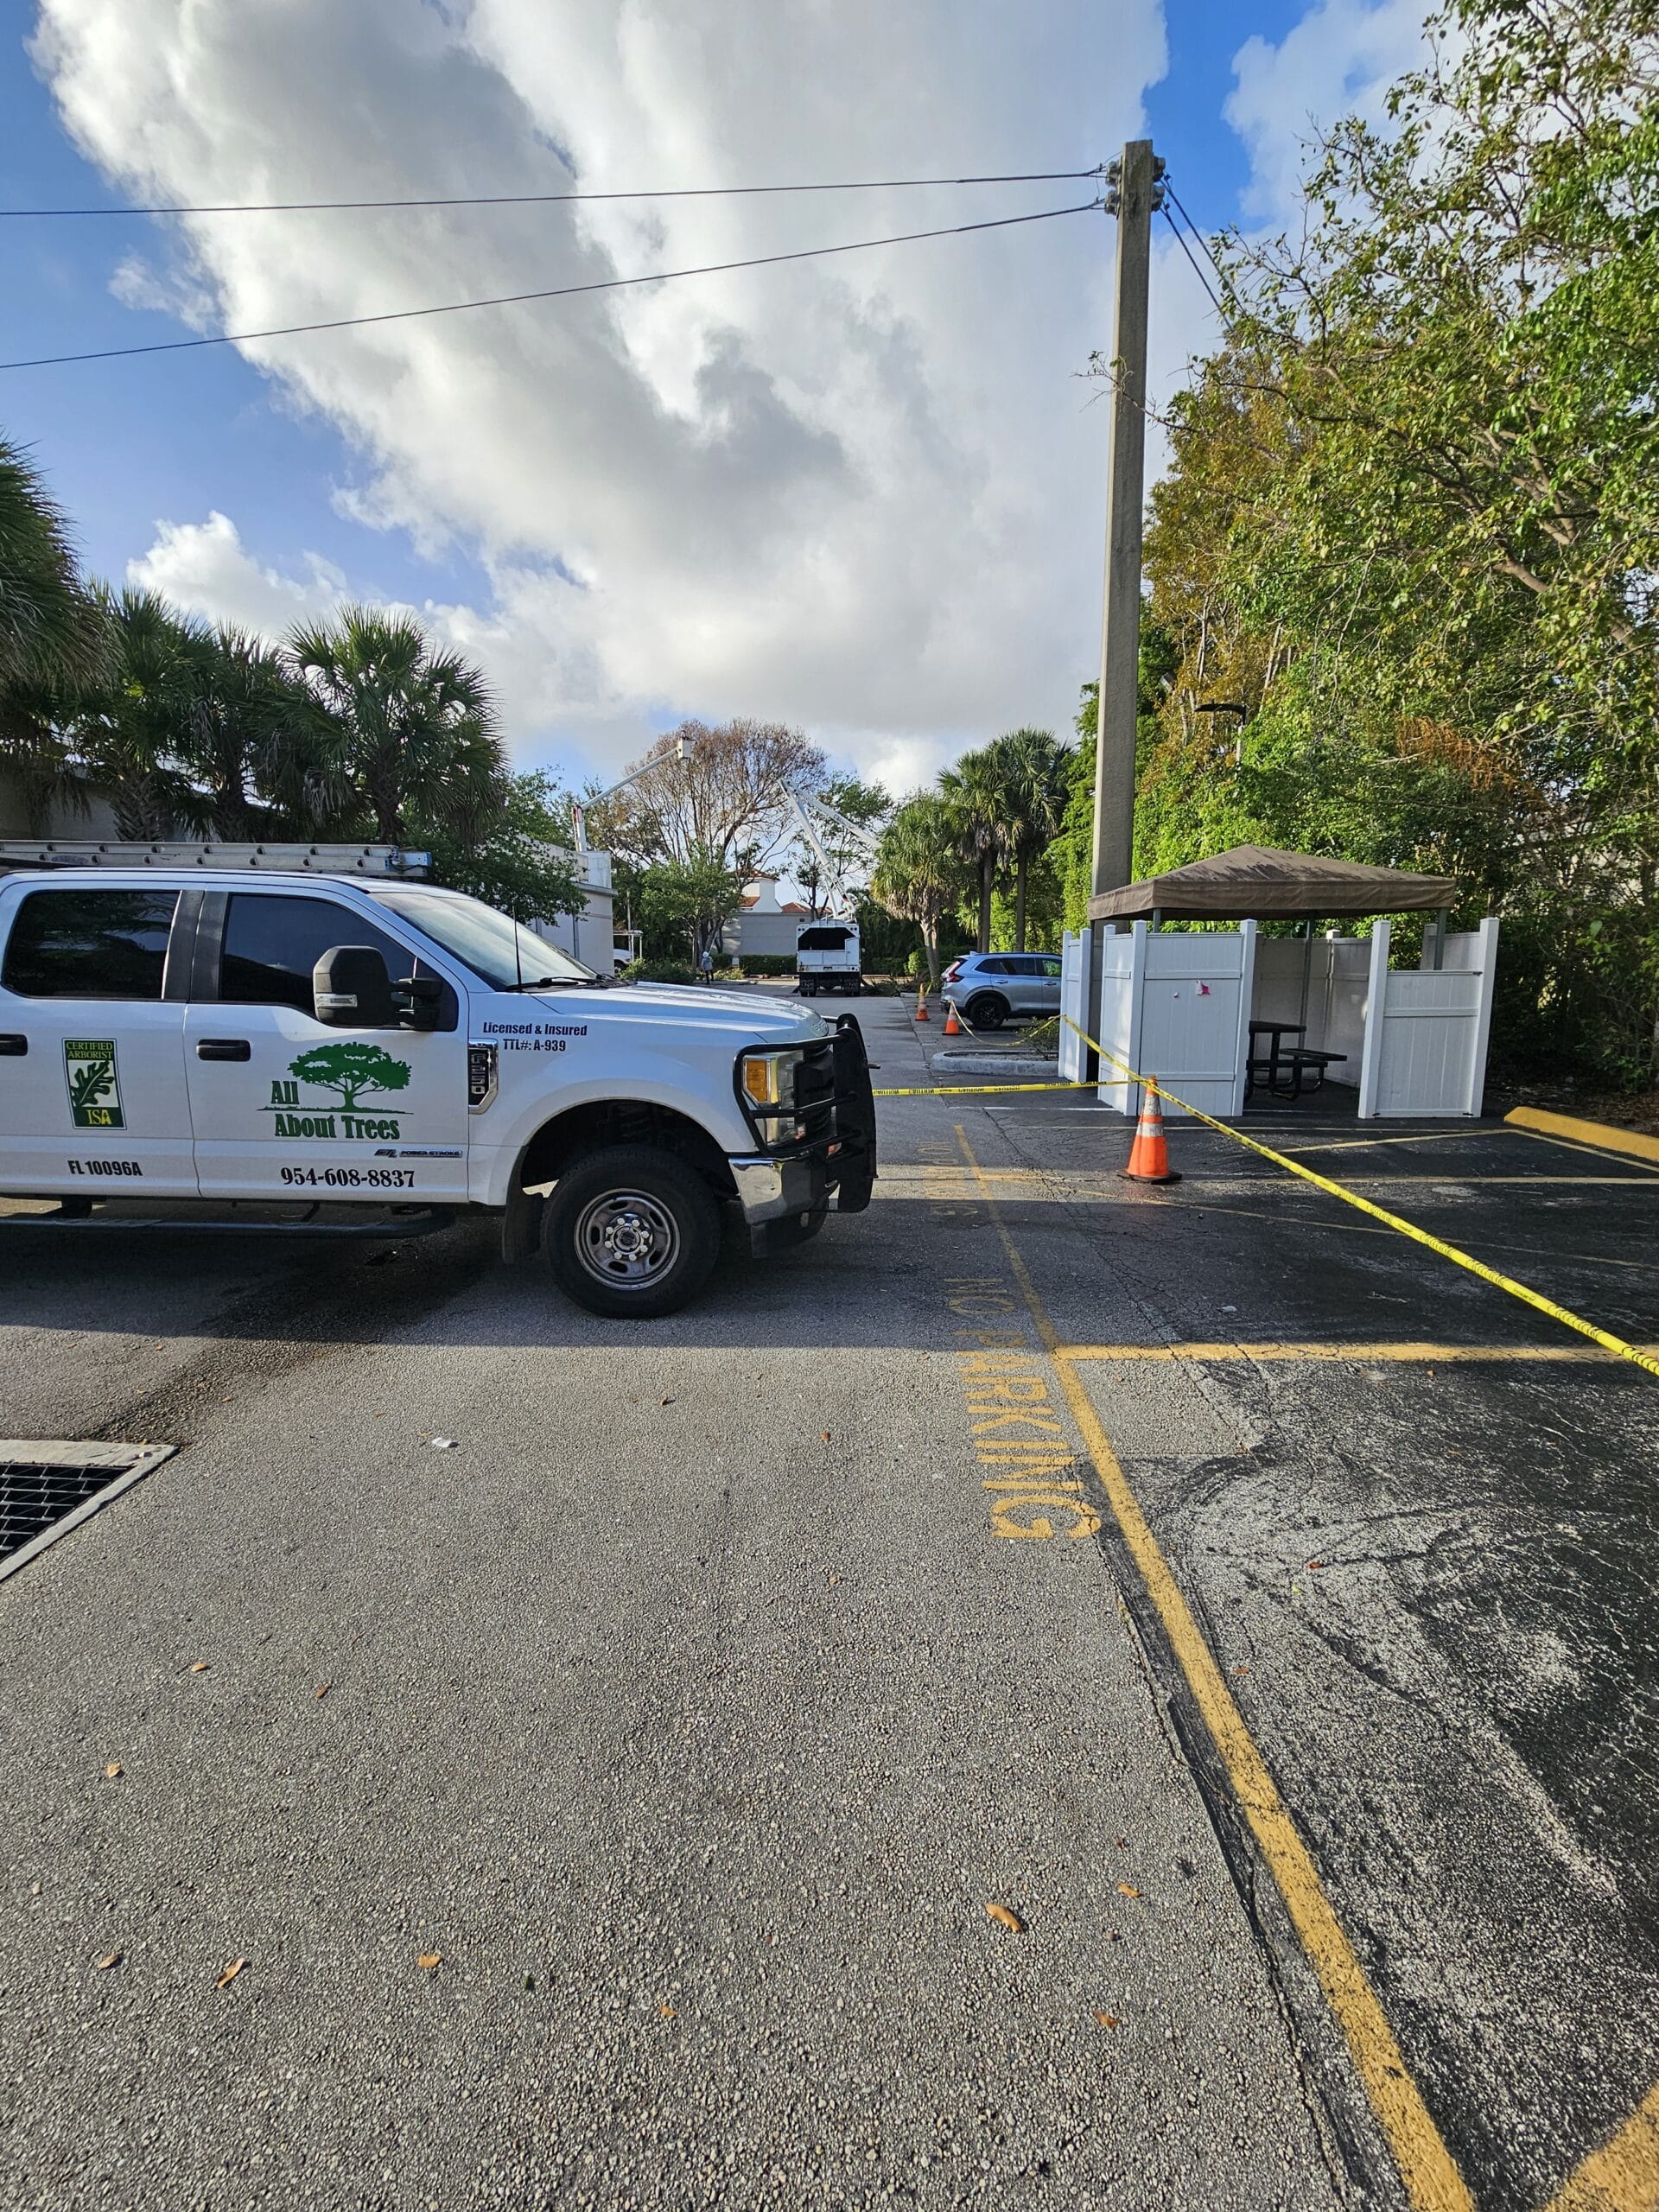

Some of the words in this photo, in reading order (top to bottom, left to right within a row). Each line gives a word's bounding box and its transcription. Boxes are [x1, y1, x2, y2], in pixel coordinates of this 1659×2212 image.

[483, 1021, 532, 1035] Licensed
[535, 1024, 543, 1035] &
[544, 1023, 588, 1036] Insured
[66, 1041, 113, 1051] CERTIFIED
[503, 1038, 532, 1051] TTL#:
[533, 1039, 566, 1052] A-939
[67, 1051, 113, 1059] ARBORIST
[270, 1080, 300, 1105] All
[86, 1109, 112, 1125] ISA
[275, 1113, 337, 1138] About
[341, 1115, 400, 1140] Trees
[67, 1160, 85, 1175] FL
[85, 1161, 143, 1177] 10096A
[281, 1166, 416, 1188] 954-608-8837
[942, 1278, 1018, 1316] NO
[953, 1328, 1103, 1540] PARKING
